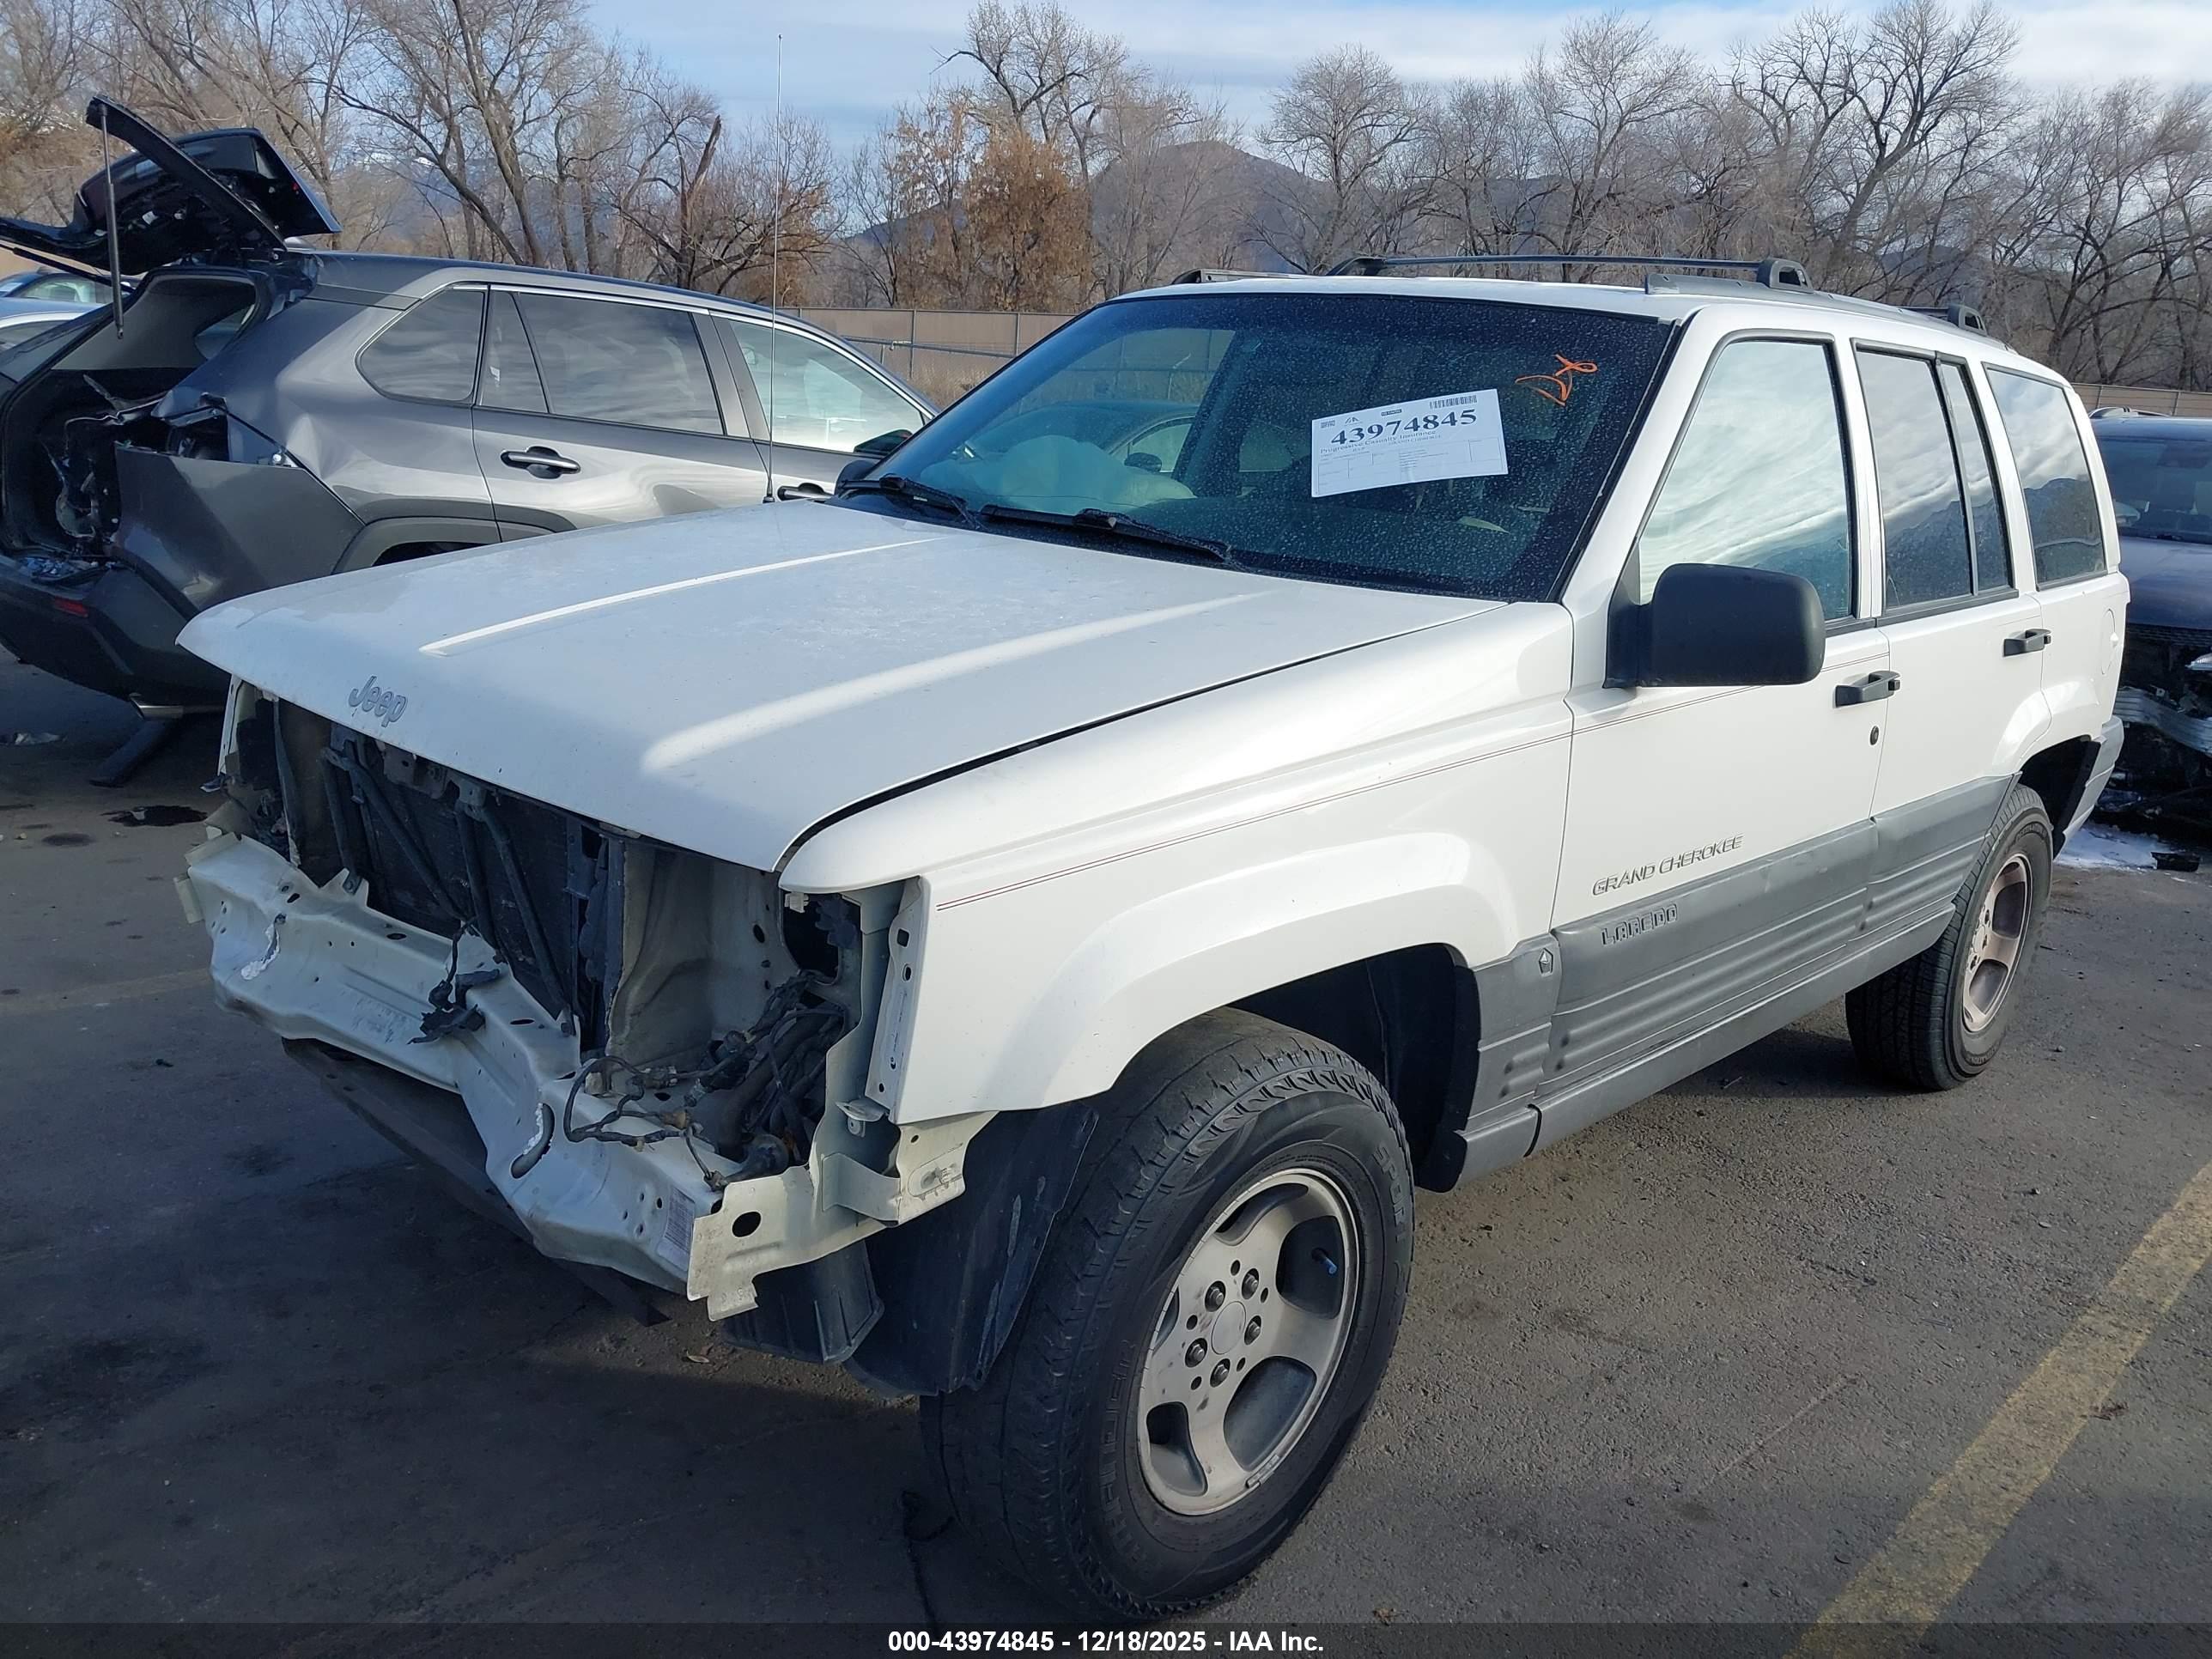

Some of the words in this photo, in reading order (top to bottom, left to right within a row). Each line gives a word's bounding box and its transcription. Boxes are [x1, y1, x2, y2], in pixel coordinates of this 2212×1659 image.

[1331, 409, 1477, 445] 43974845
[1400, 430, 1437, 440] Insurance
[348, 675, 407, 728] Jeep
[1592, 864, 1656, 896] GRAND
[1659, 834, 1744, 874] CHEROKEE
[1601, 903, 1679, 945] LAREDO
